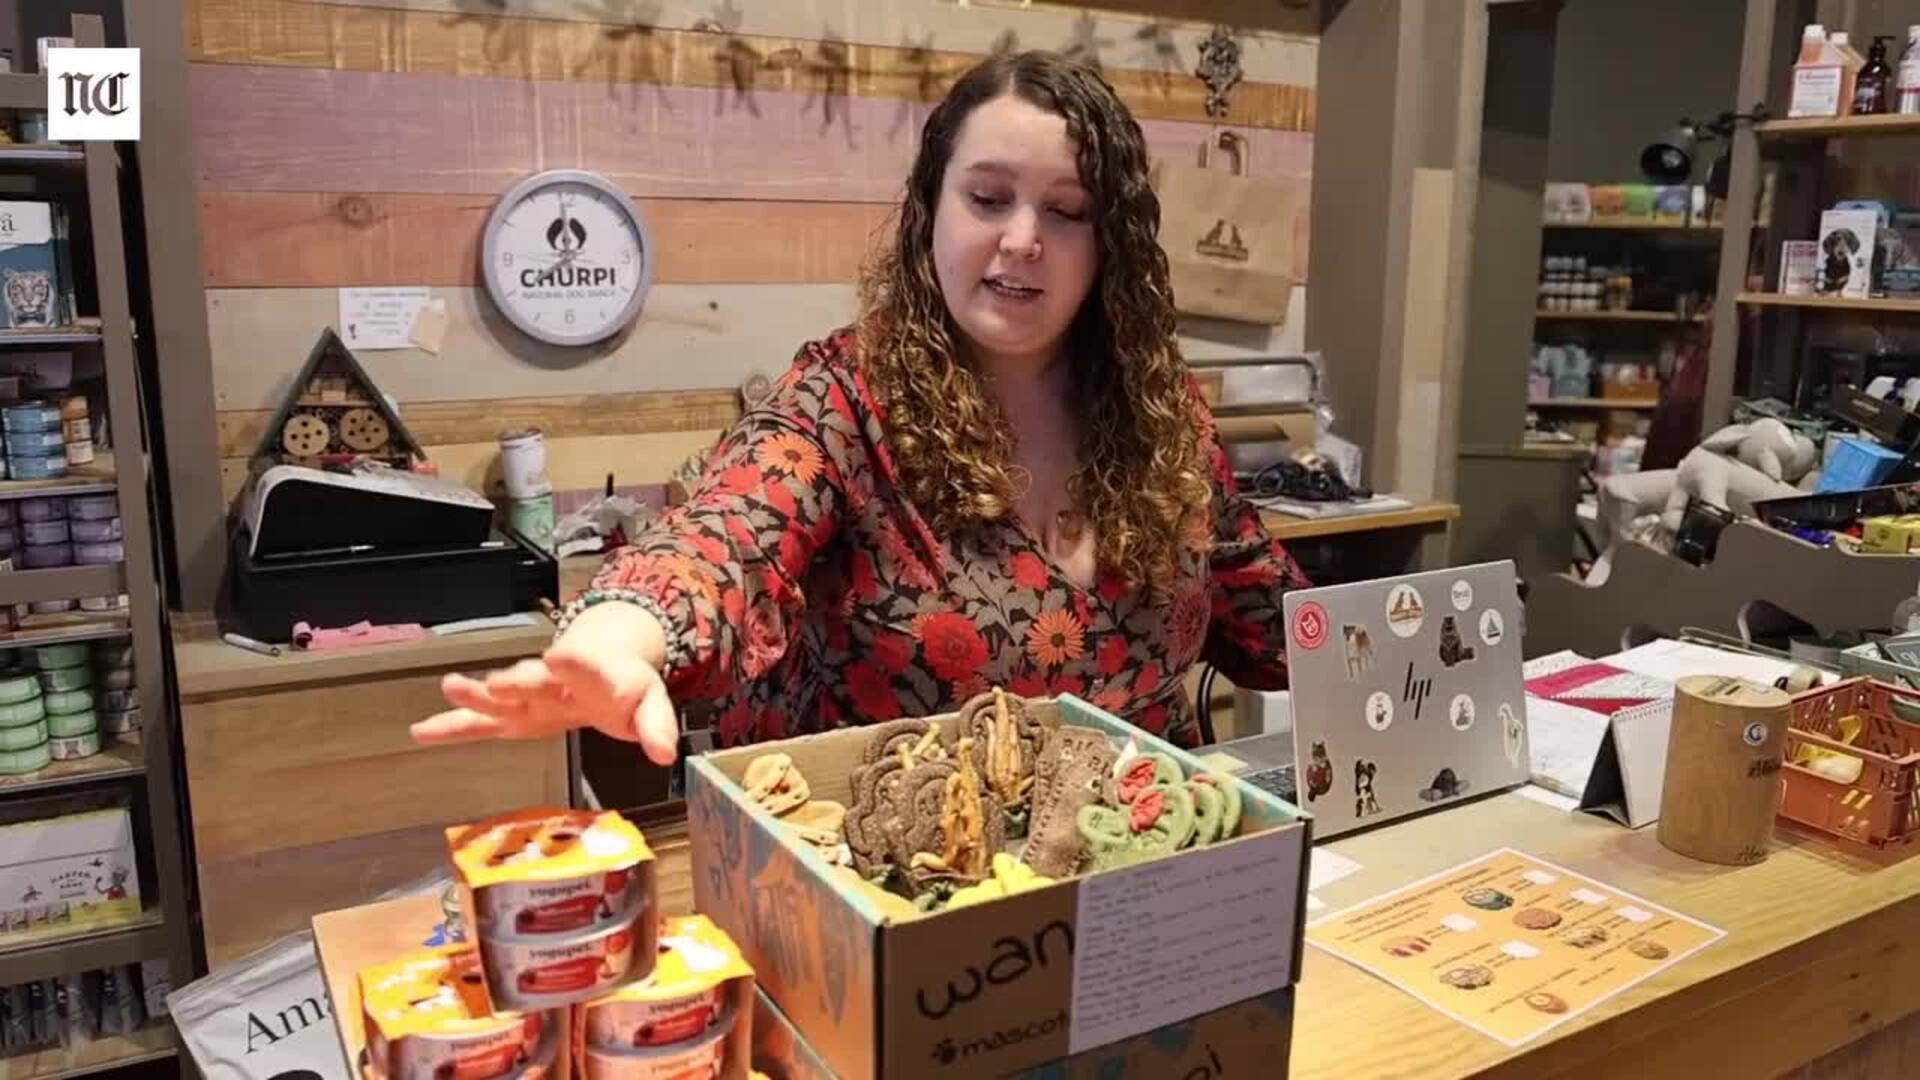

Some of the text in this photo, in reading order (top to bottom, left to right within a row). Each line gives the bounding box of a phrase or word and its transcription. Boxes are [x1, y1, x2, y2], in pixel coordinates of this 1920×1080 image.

[520, 267, 616, 288] CHURPI
[1403, 661, 1432, 720] hp
[916, 920, 1076, 1020] wan
[244, 992, 331, 1055] Am
